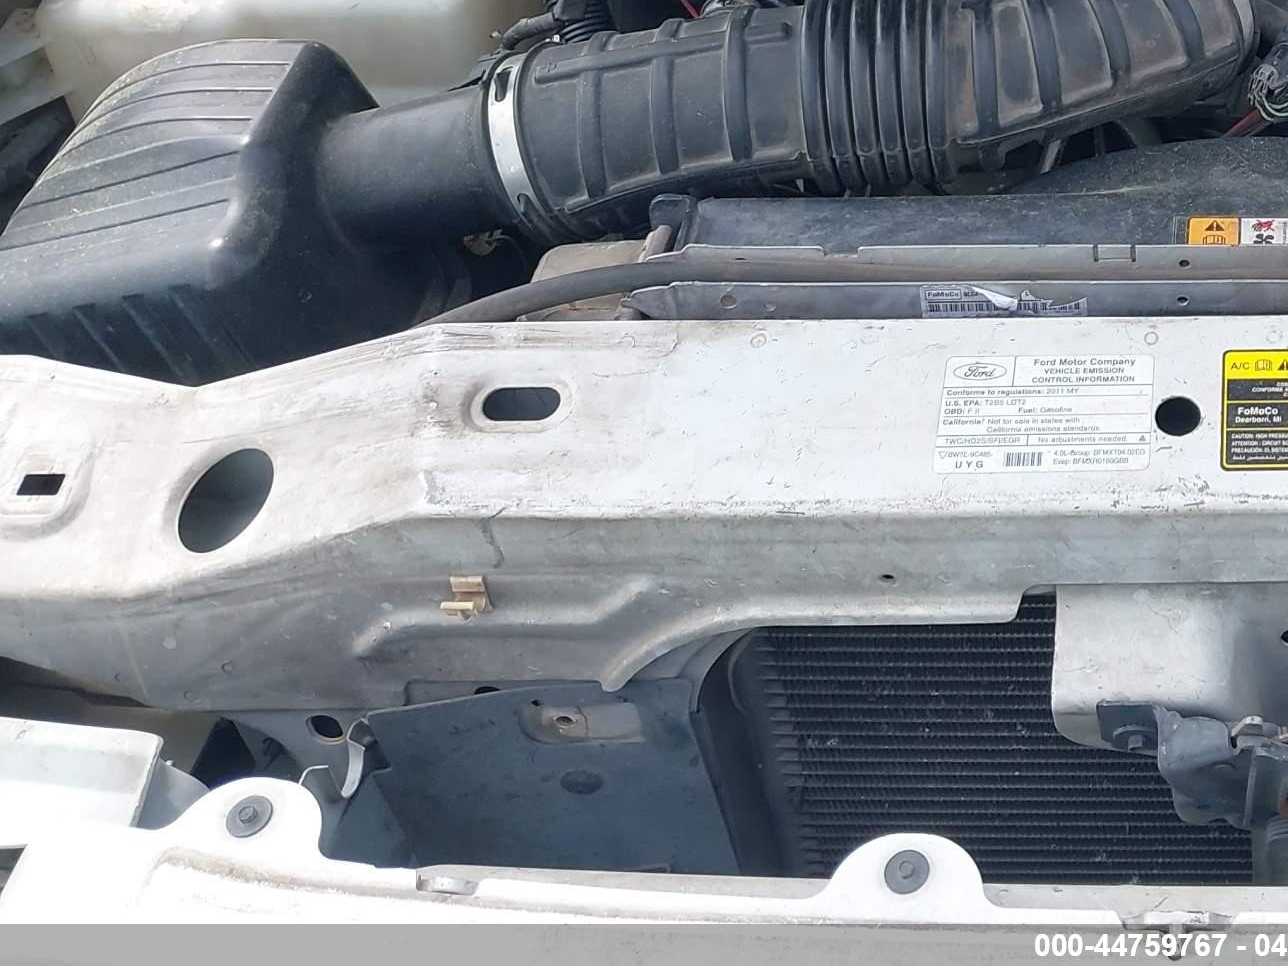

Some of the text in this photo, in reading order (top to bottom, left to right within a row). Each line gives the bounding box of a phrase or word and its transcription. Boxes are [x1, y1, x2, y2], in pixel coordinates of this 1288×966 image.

[1090, 358, 1136, 366] Company
[1231, 362, 1250, 370] A/C
[964, 366, 996, 377] Ford
[1238, 407, 1278, 415] FoMoCo
